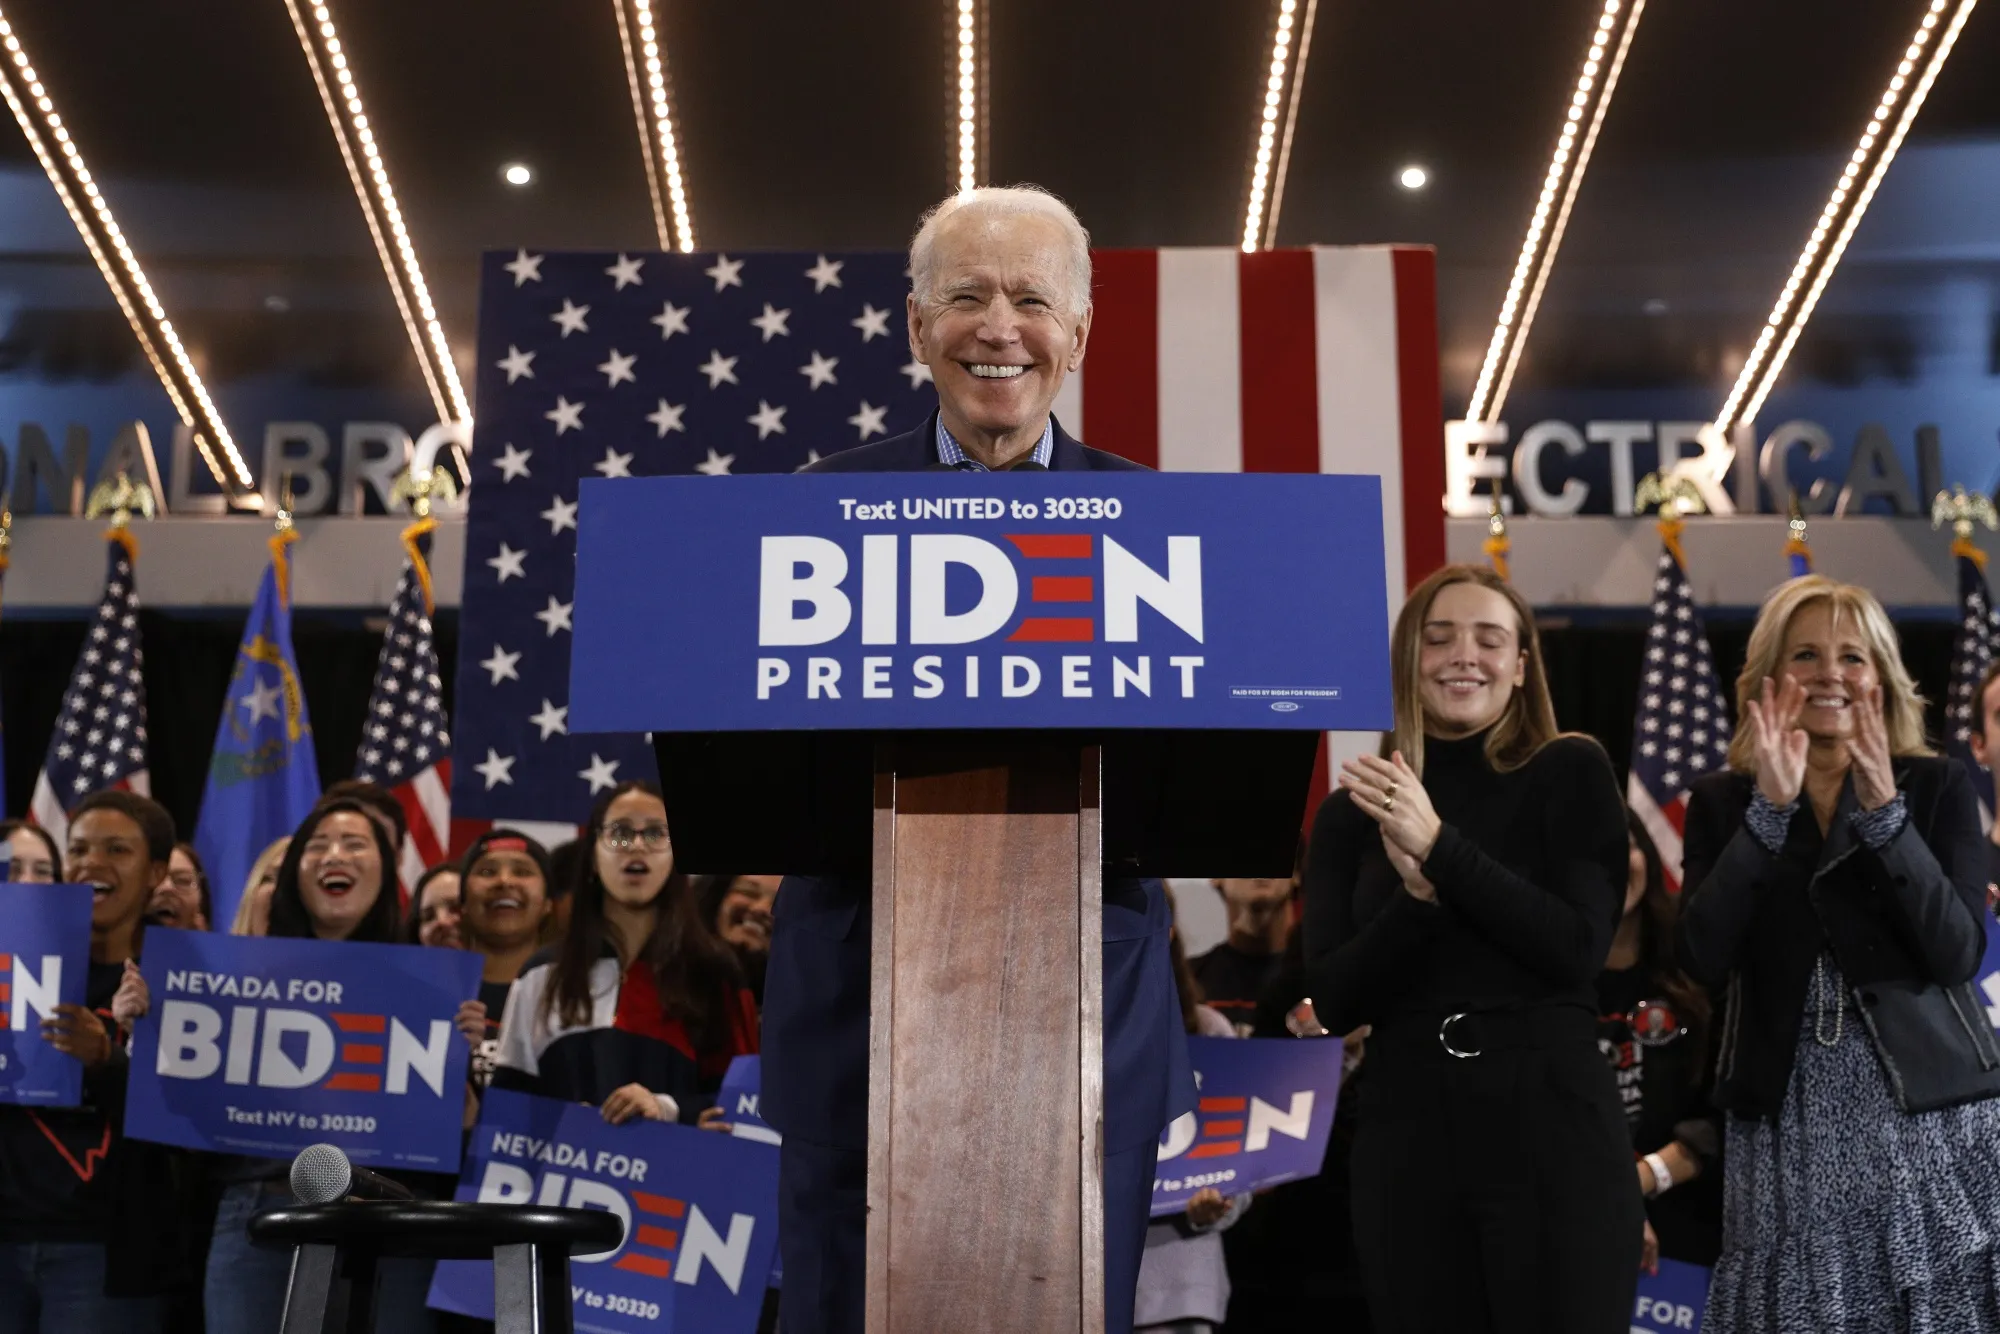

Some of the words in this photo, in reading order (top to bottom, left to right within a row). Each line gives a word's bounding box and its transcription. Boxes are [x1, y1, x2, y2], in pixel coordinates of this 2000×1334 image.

[0, 421, 264, 517] NAL
[1443, 419, 1944, 517] ECTRICAL
[839, 498, 896, 520] Text
[902, 498, 1005, 520] UNITED
[1010, 499, 1038, 519] to
[1043, 497, 1122, 520] 30330
[758, 534, 1204, 646] BIDEN
[757, 655, 1205, 700] PRESIDENT
[1270, 689, 1290, 697] BIDEN
[165, 970, 281, 1001] NEVADA
[287, 979, 344, 1004] FOR
[156, 999, 452, 1099] BIDEN
[226, 1106, 263, 1126] Text
[266, 1111, 296, 1128] NV
[299, 1111, 318, 1130] to
[320, 1114, 377, 1134] 30330
[491, 1132, 589, 1172] NEVADA
[594, 1151, 648, 1182] FOR
[1163, 1179, 1182, 1192] to
[1183, 1169, 1236, 1189] 30330
[584, 1290, 605, 1308] to
[605, 1293, 660, 1320] 30330
[1635, 1296, 1694, 1330] FOR
